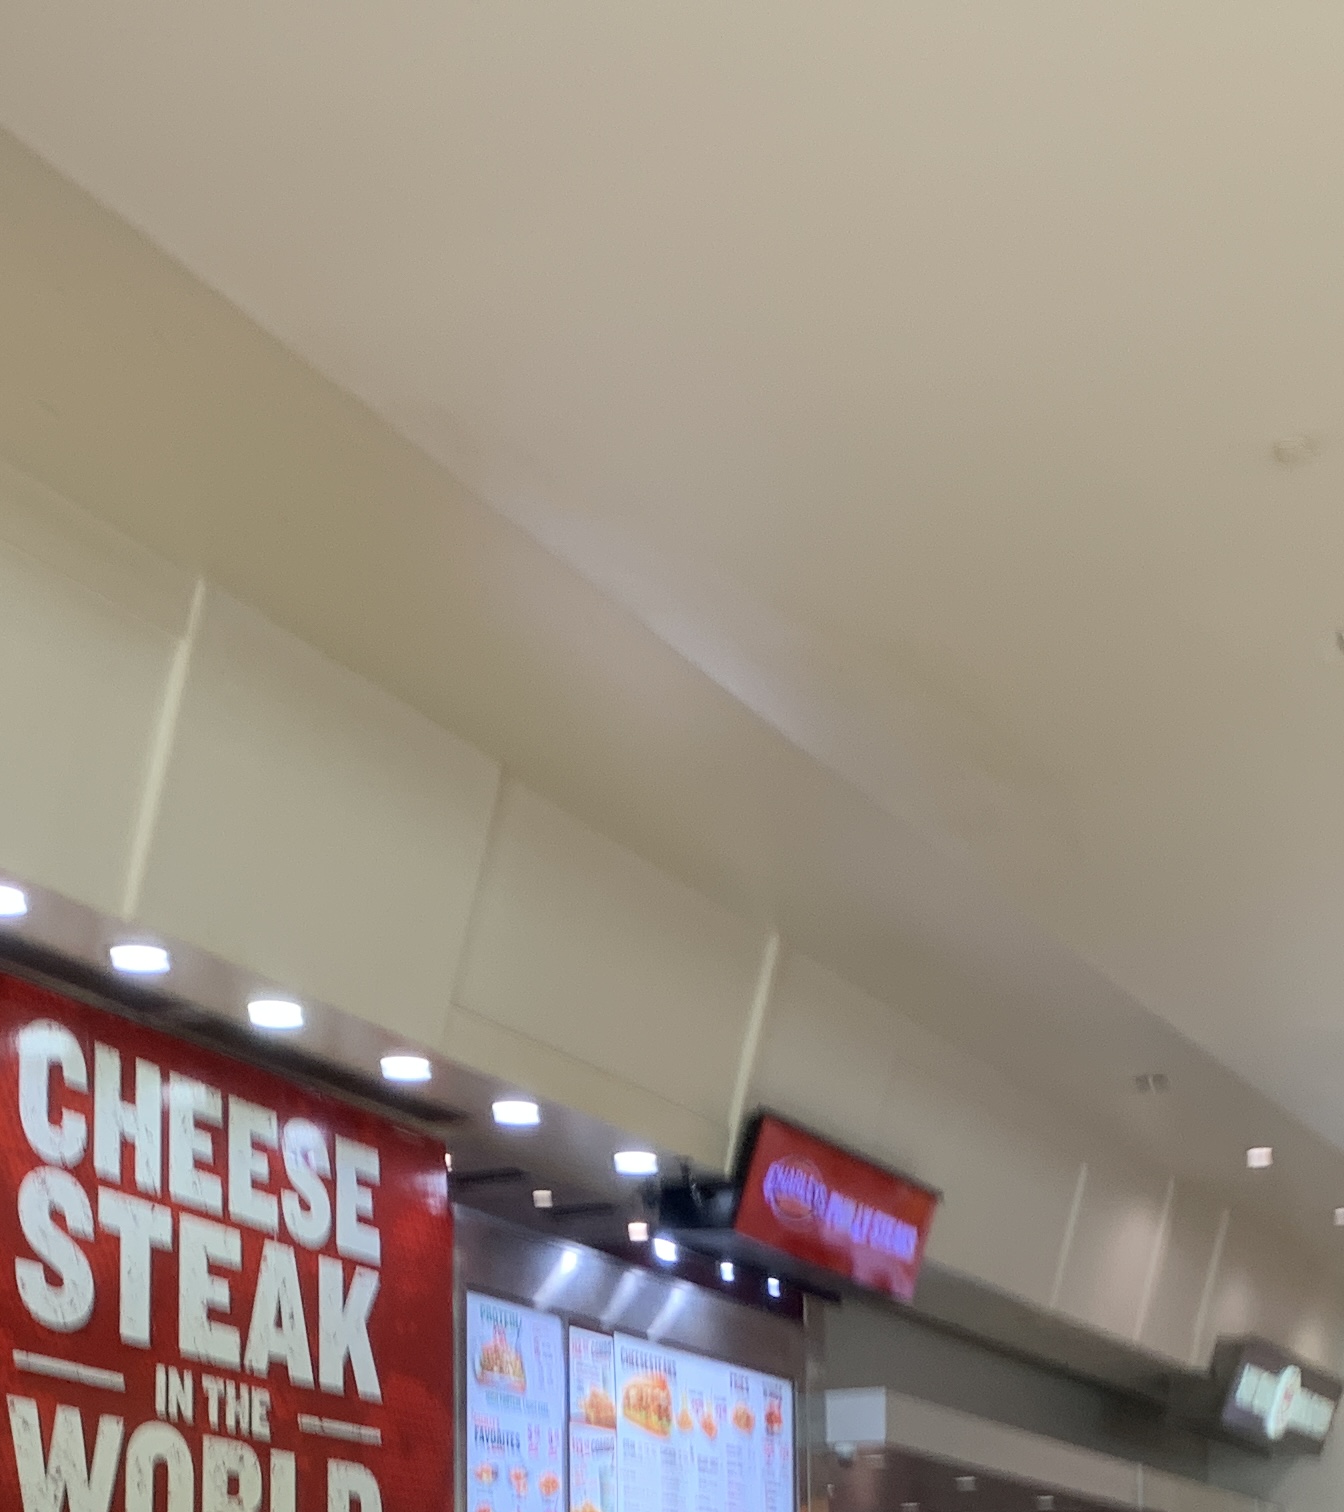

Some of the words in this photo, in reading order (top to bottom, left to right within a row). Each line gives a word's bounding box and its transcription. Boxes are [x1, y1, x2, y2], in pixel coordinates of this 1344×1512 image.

[11, 1018, 383, 1267] CHEESE
[13, 1166, 383, 1402] STEAK
[154, 1363, 195, 1427] IN
[201, 1373, 270, 1441] THE
